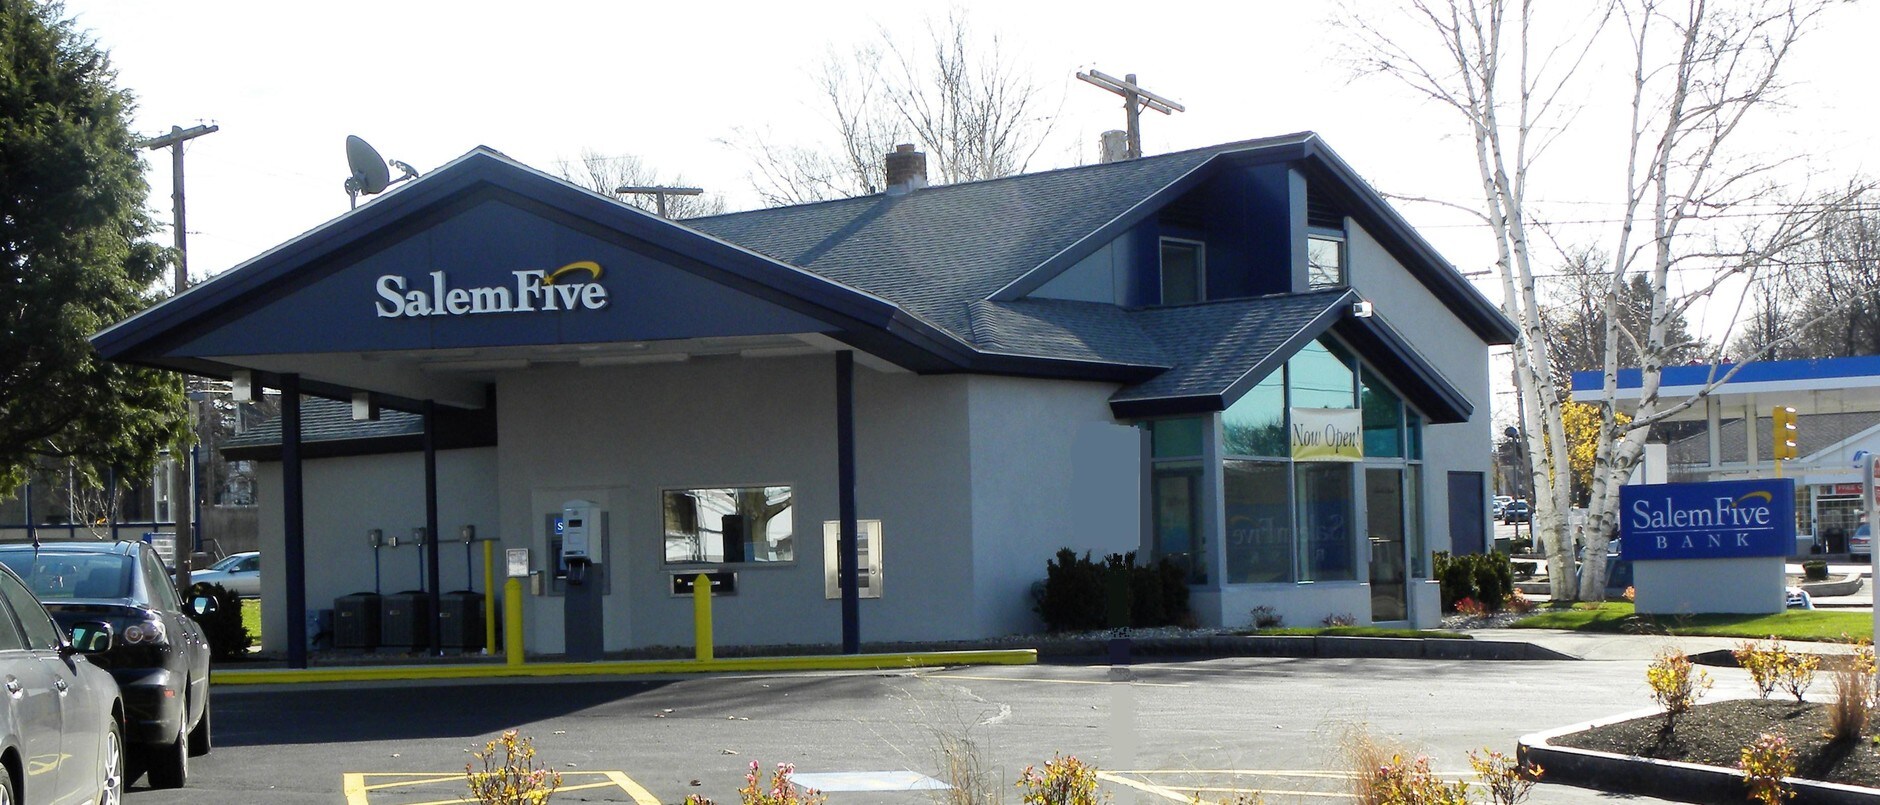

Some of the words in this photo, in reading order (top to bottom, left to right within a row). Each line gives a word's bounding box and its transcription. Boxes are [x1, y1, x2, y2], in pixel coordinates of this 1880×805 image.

[1293, 423, 1321, 447] Now
[1325, 423, 1360, 454] Open!
[1656, 533, 1749, 549] BANK
